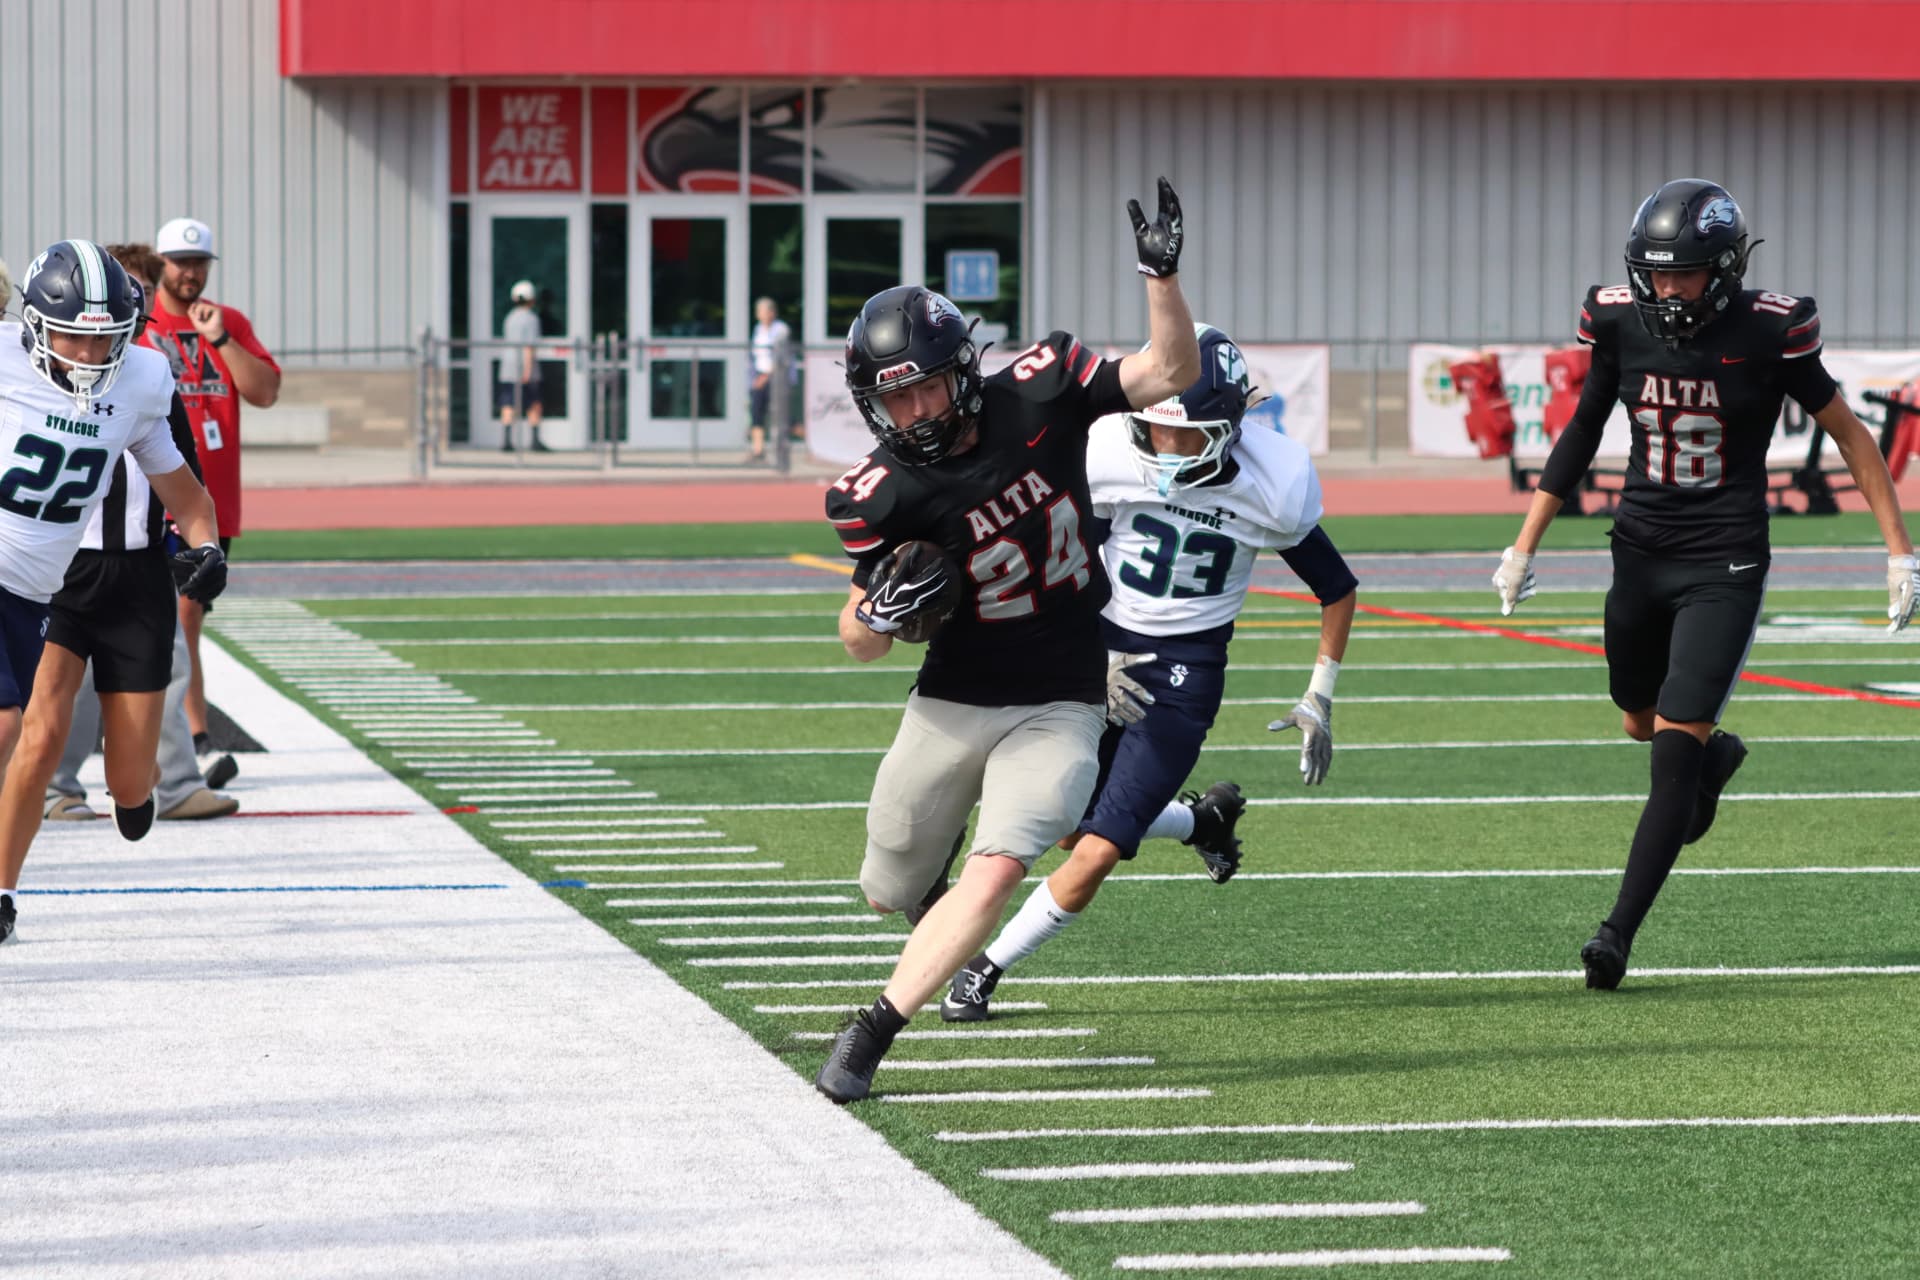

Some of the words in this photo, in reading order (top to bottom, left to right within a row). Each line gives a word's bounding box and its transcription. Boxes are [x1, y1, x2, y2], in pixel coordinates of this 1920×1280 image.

[501, 94, 562, 123] WE
[489, 126, 570, 154] ARE
[481, 157, 576, 187] ALTA
[1595, 285, 1634, 305] 8
[1752, 291, 1799, 316] 18
[81, 314, 111, 323] Riddell
[1013, 342, 1057, 382] 2
[1640, 373, 1721, 408] ALTA
[45, 413, 101, 438] SYRACUSE
[1147, 404, 1183, 418] Riddell
[1633, 405, 1728, 489] 18
[0, 432, 109, 524] 22
[831, 454, 892, 503] 24
[963, 468, 1054, 543] ALTA
[967, 490, 1090, 622] 24
[1118, 511, 1238, 599] 33
